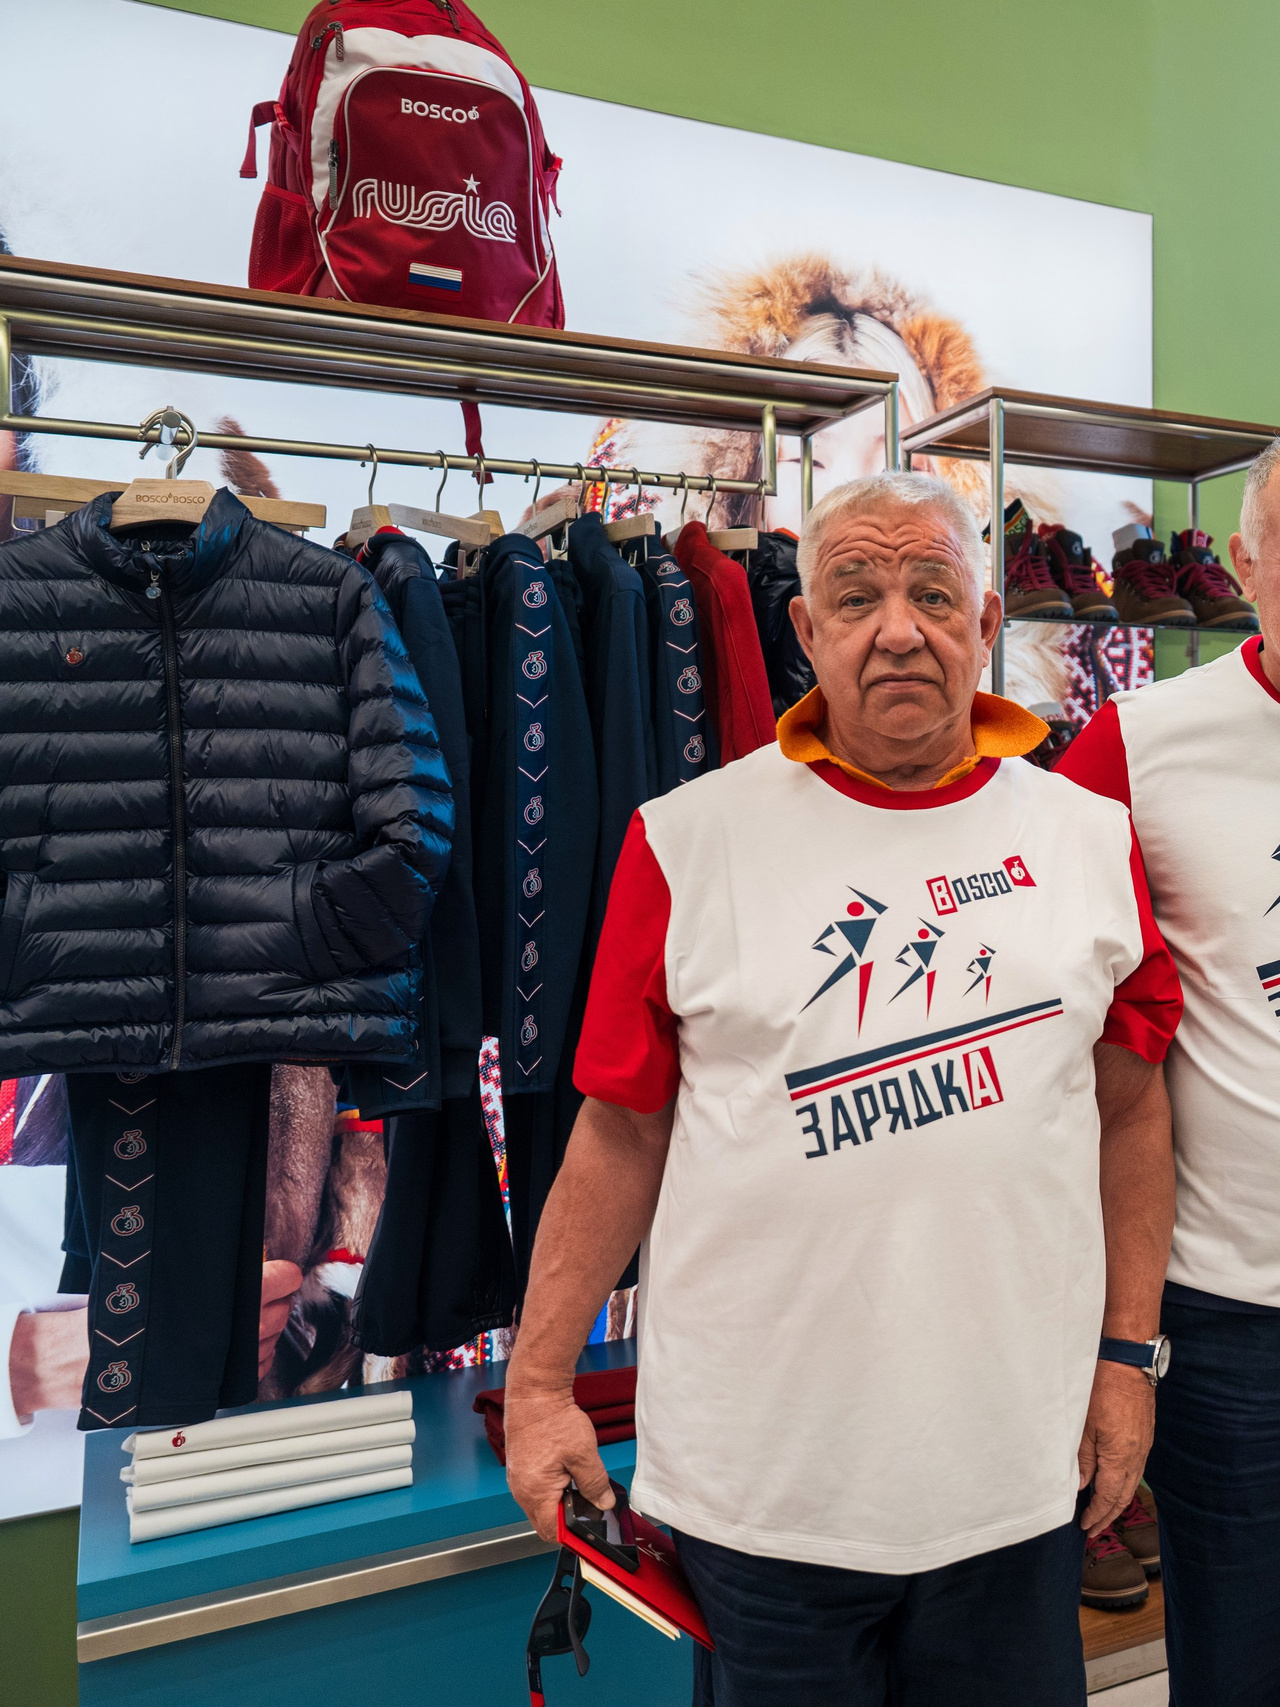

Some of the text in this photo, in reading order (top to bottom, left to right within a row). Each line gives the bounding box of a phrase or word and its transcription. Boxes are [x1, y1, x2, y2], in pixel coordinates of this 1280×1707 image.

[401, 98, 468, 124] BOSCO
[352, 173, 517, 243] russia
[135, 494, 205, 504] BOSCO BOSCO
[926, 868, 1012, 916] BOSCO
[795, 1046, 1004, 1159] ЗАРЯДКА
